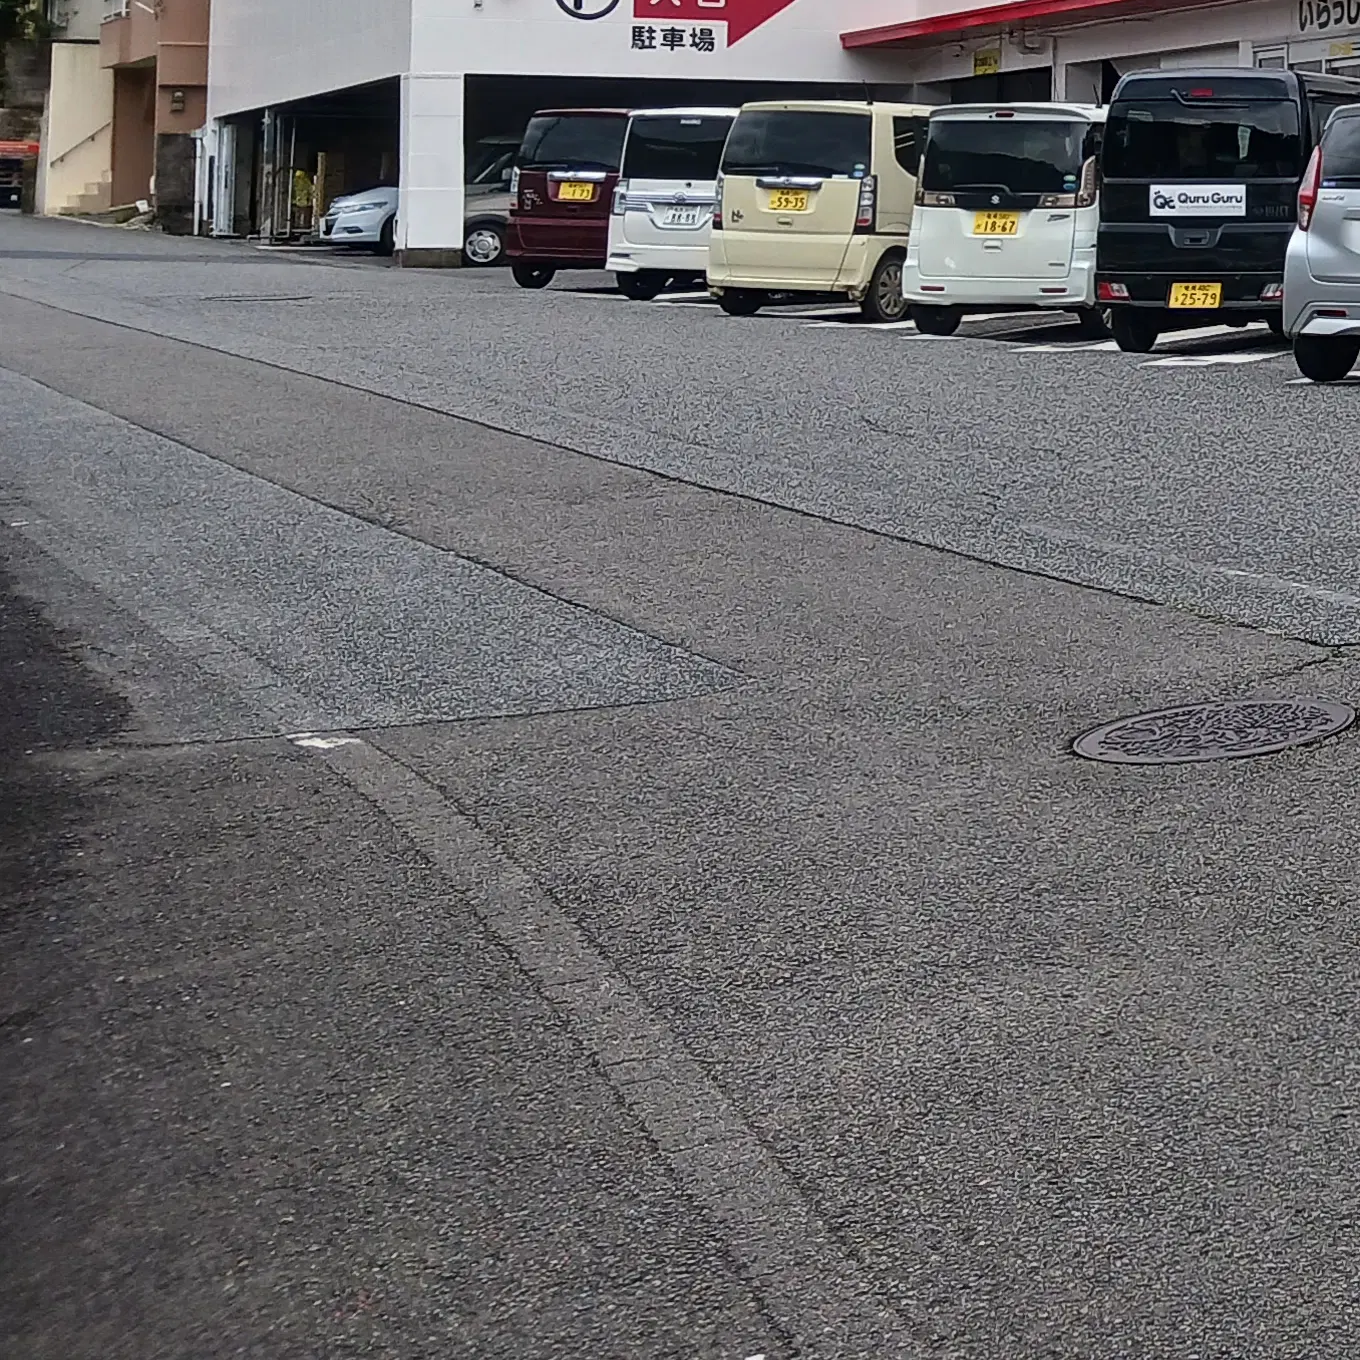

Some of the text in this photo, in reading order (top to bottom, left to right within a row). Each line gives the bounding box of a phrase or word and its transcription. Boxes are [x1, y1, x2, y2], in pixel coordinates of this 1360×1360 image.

[631, 25, 716, 52] 駐車場
[1177, 192, 1243, 204] Quru Guru
[984, 221, 1015, 232] 18-67
[1180, 293, 1217, 305] 25-79
